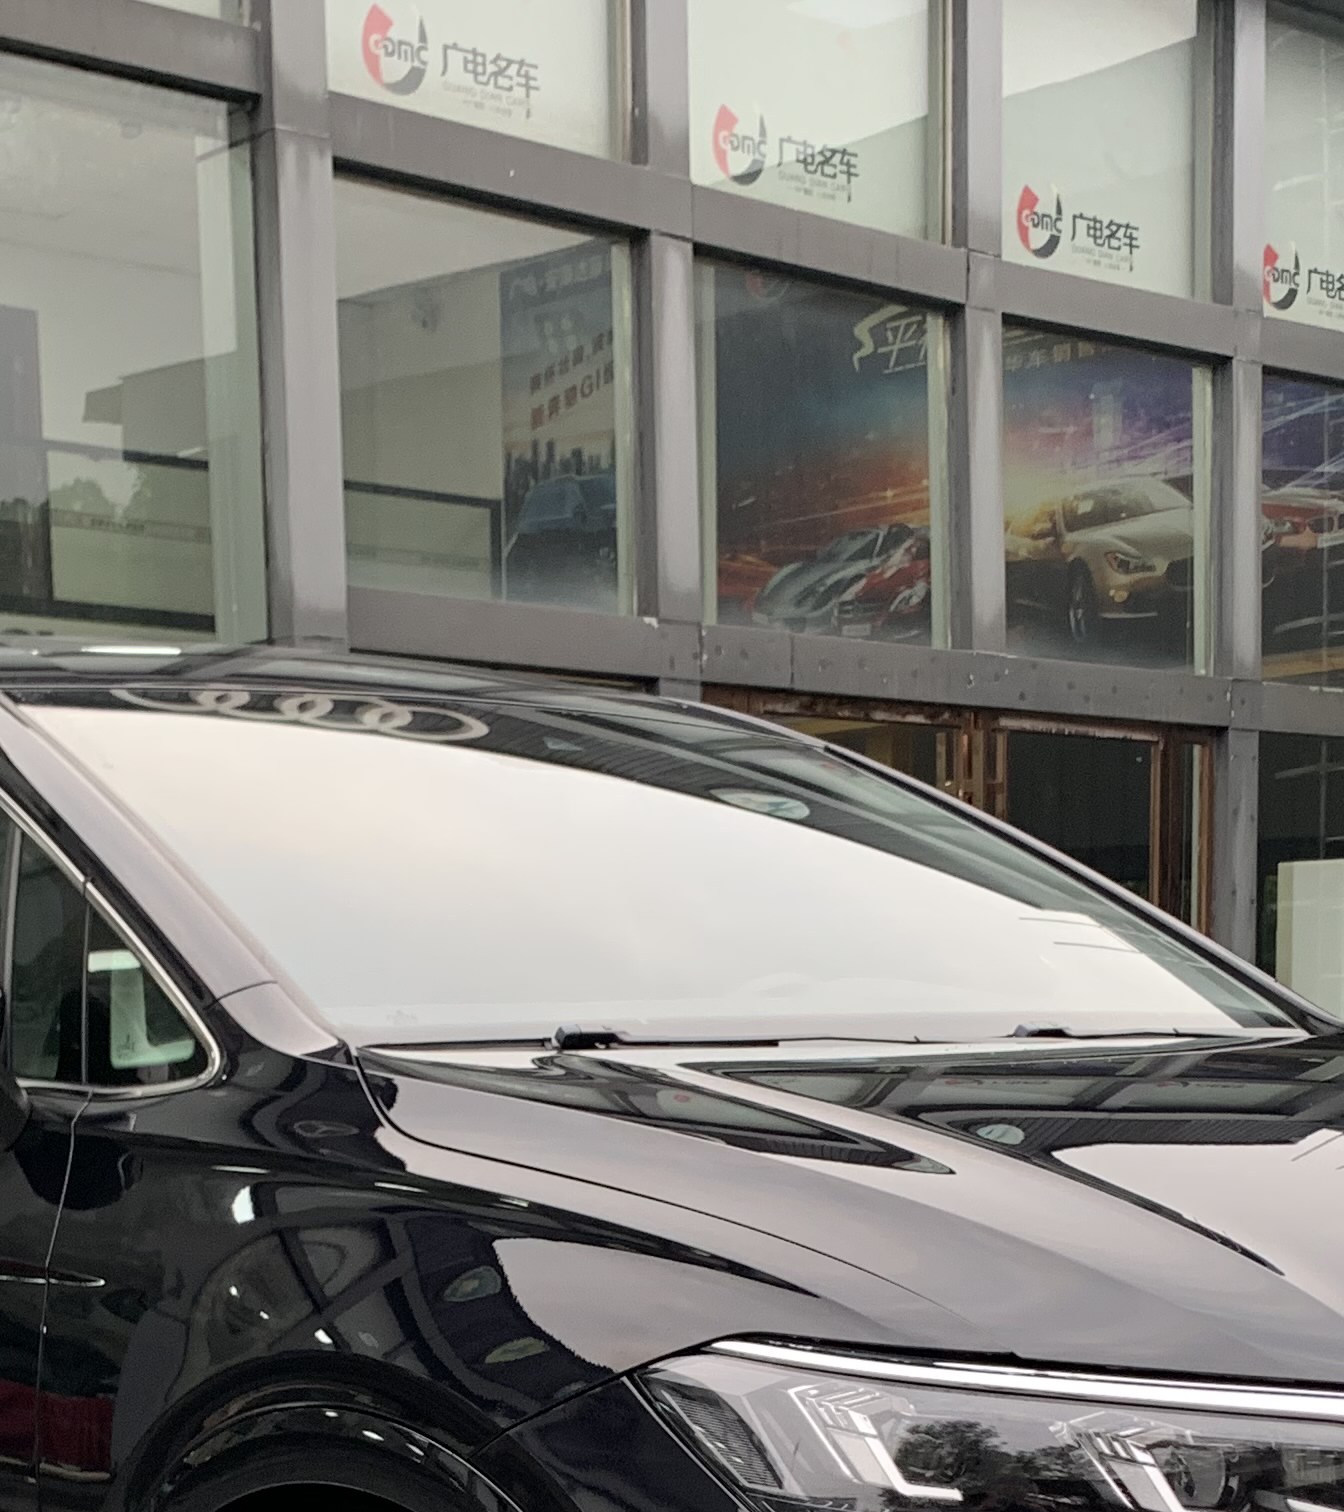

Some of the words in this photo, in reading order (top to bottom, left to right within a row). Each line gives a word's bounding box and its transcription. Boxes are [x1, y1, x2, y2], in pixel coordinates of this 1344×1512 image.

[440, 42, 541, 119] 广电名车
[777, 136, 859, 203] 广电名车
[1071, 212, 1140, 272] 广电名车
